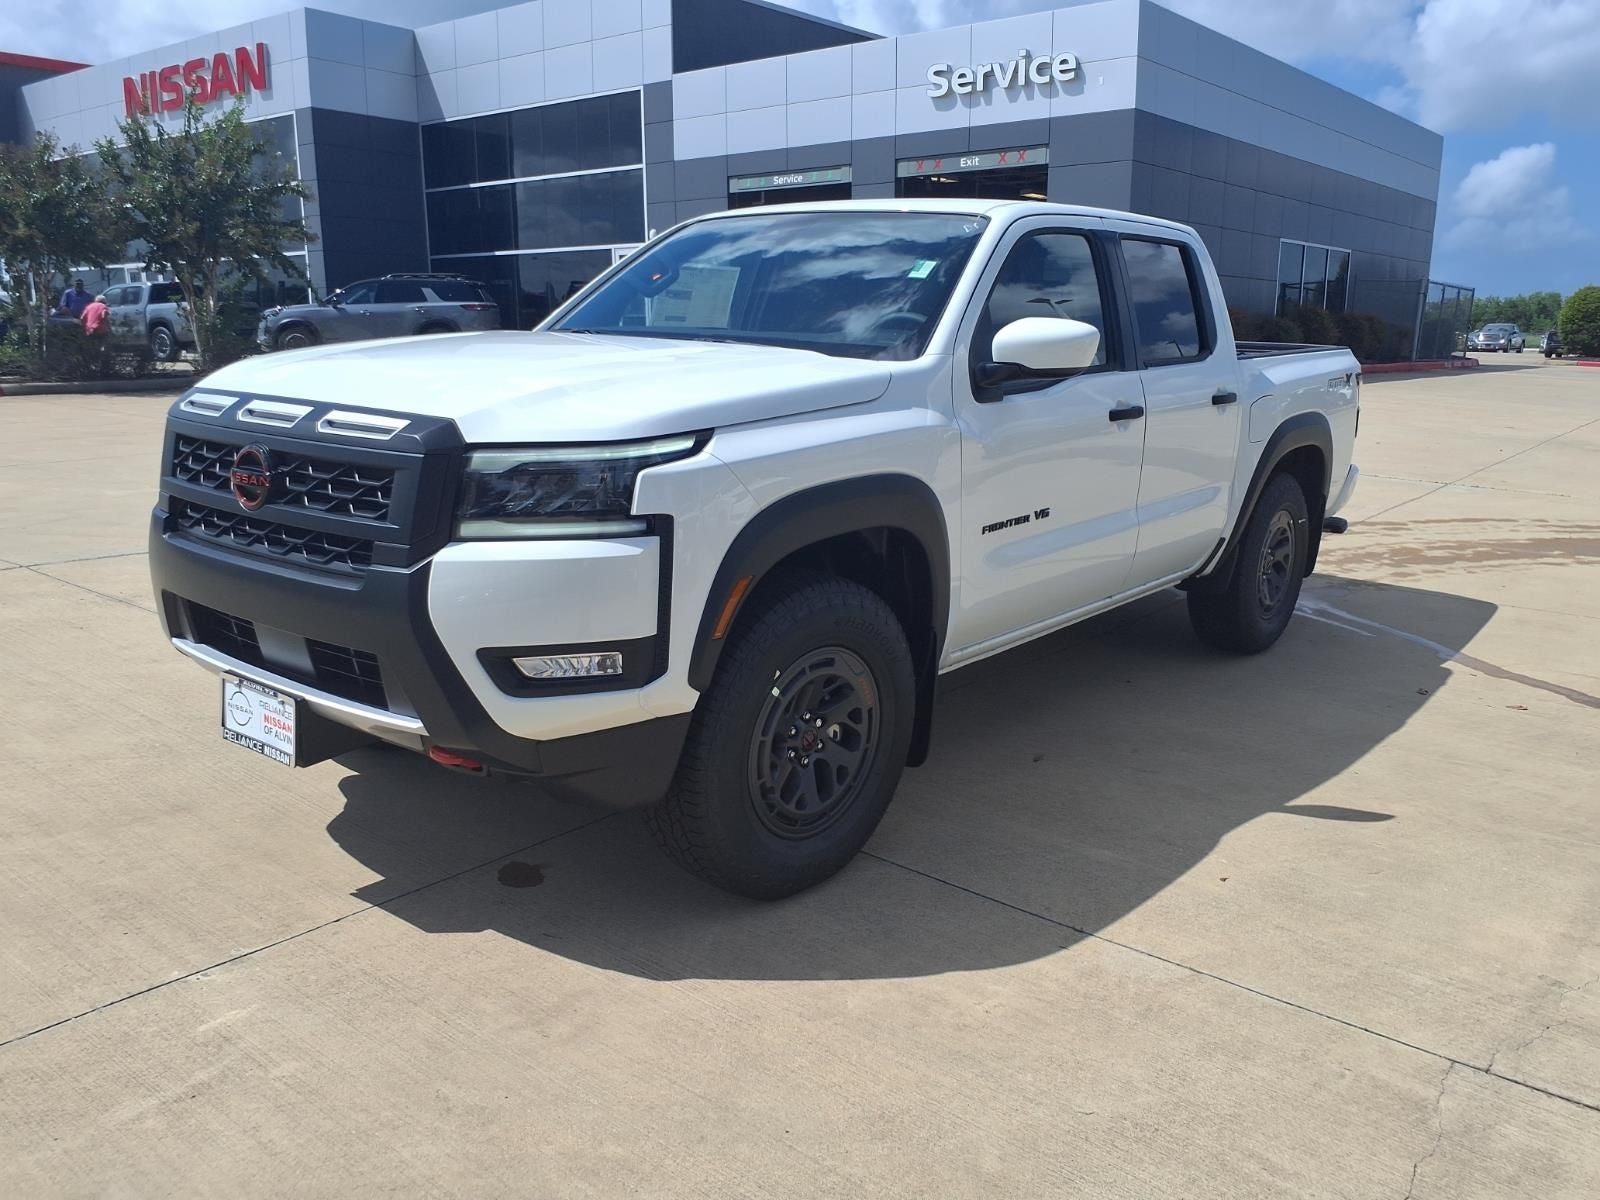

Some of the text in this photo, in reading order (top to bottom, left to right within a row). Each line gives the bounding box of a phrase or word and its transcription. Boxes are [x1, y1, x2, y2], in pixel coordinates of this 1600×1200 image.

[123, 42, 267, 118] NISSAN
[926, 49, 1077, 98] Service
[960, 156, 980, 168] Exit
[773, 174, 803, 185] Service
[234, 471, 270, 487] SSAN
[982, 507, 1051, 535] FRONTIER V6
[228, 701, 254, 716] NISSAN
[259, 700, 293, 720] RELIANCE
[264, 713, 293, 734] NISSAN
[264, 725, 293, 746] OF ALVIN
[224, 730, 290, 766] RELIANCE NISSAN
